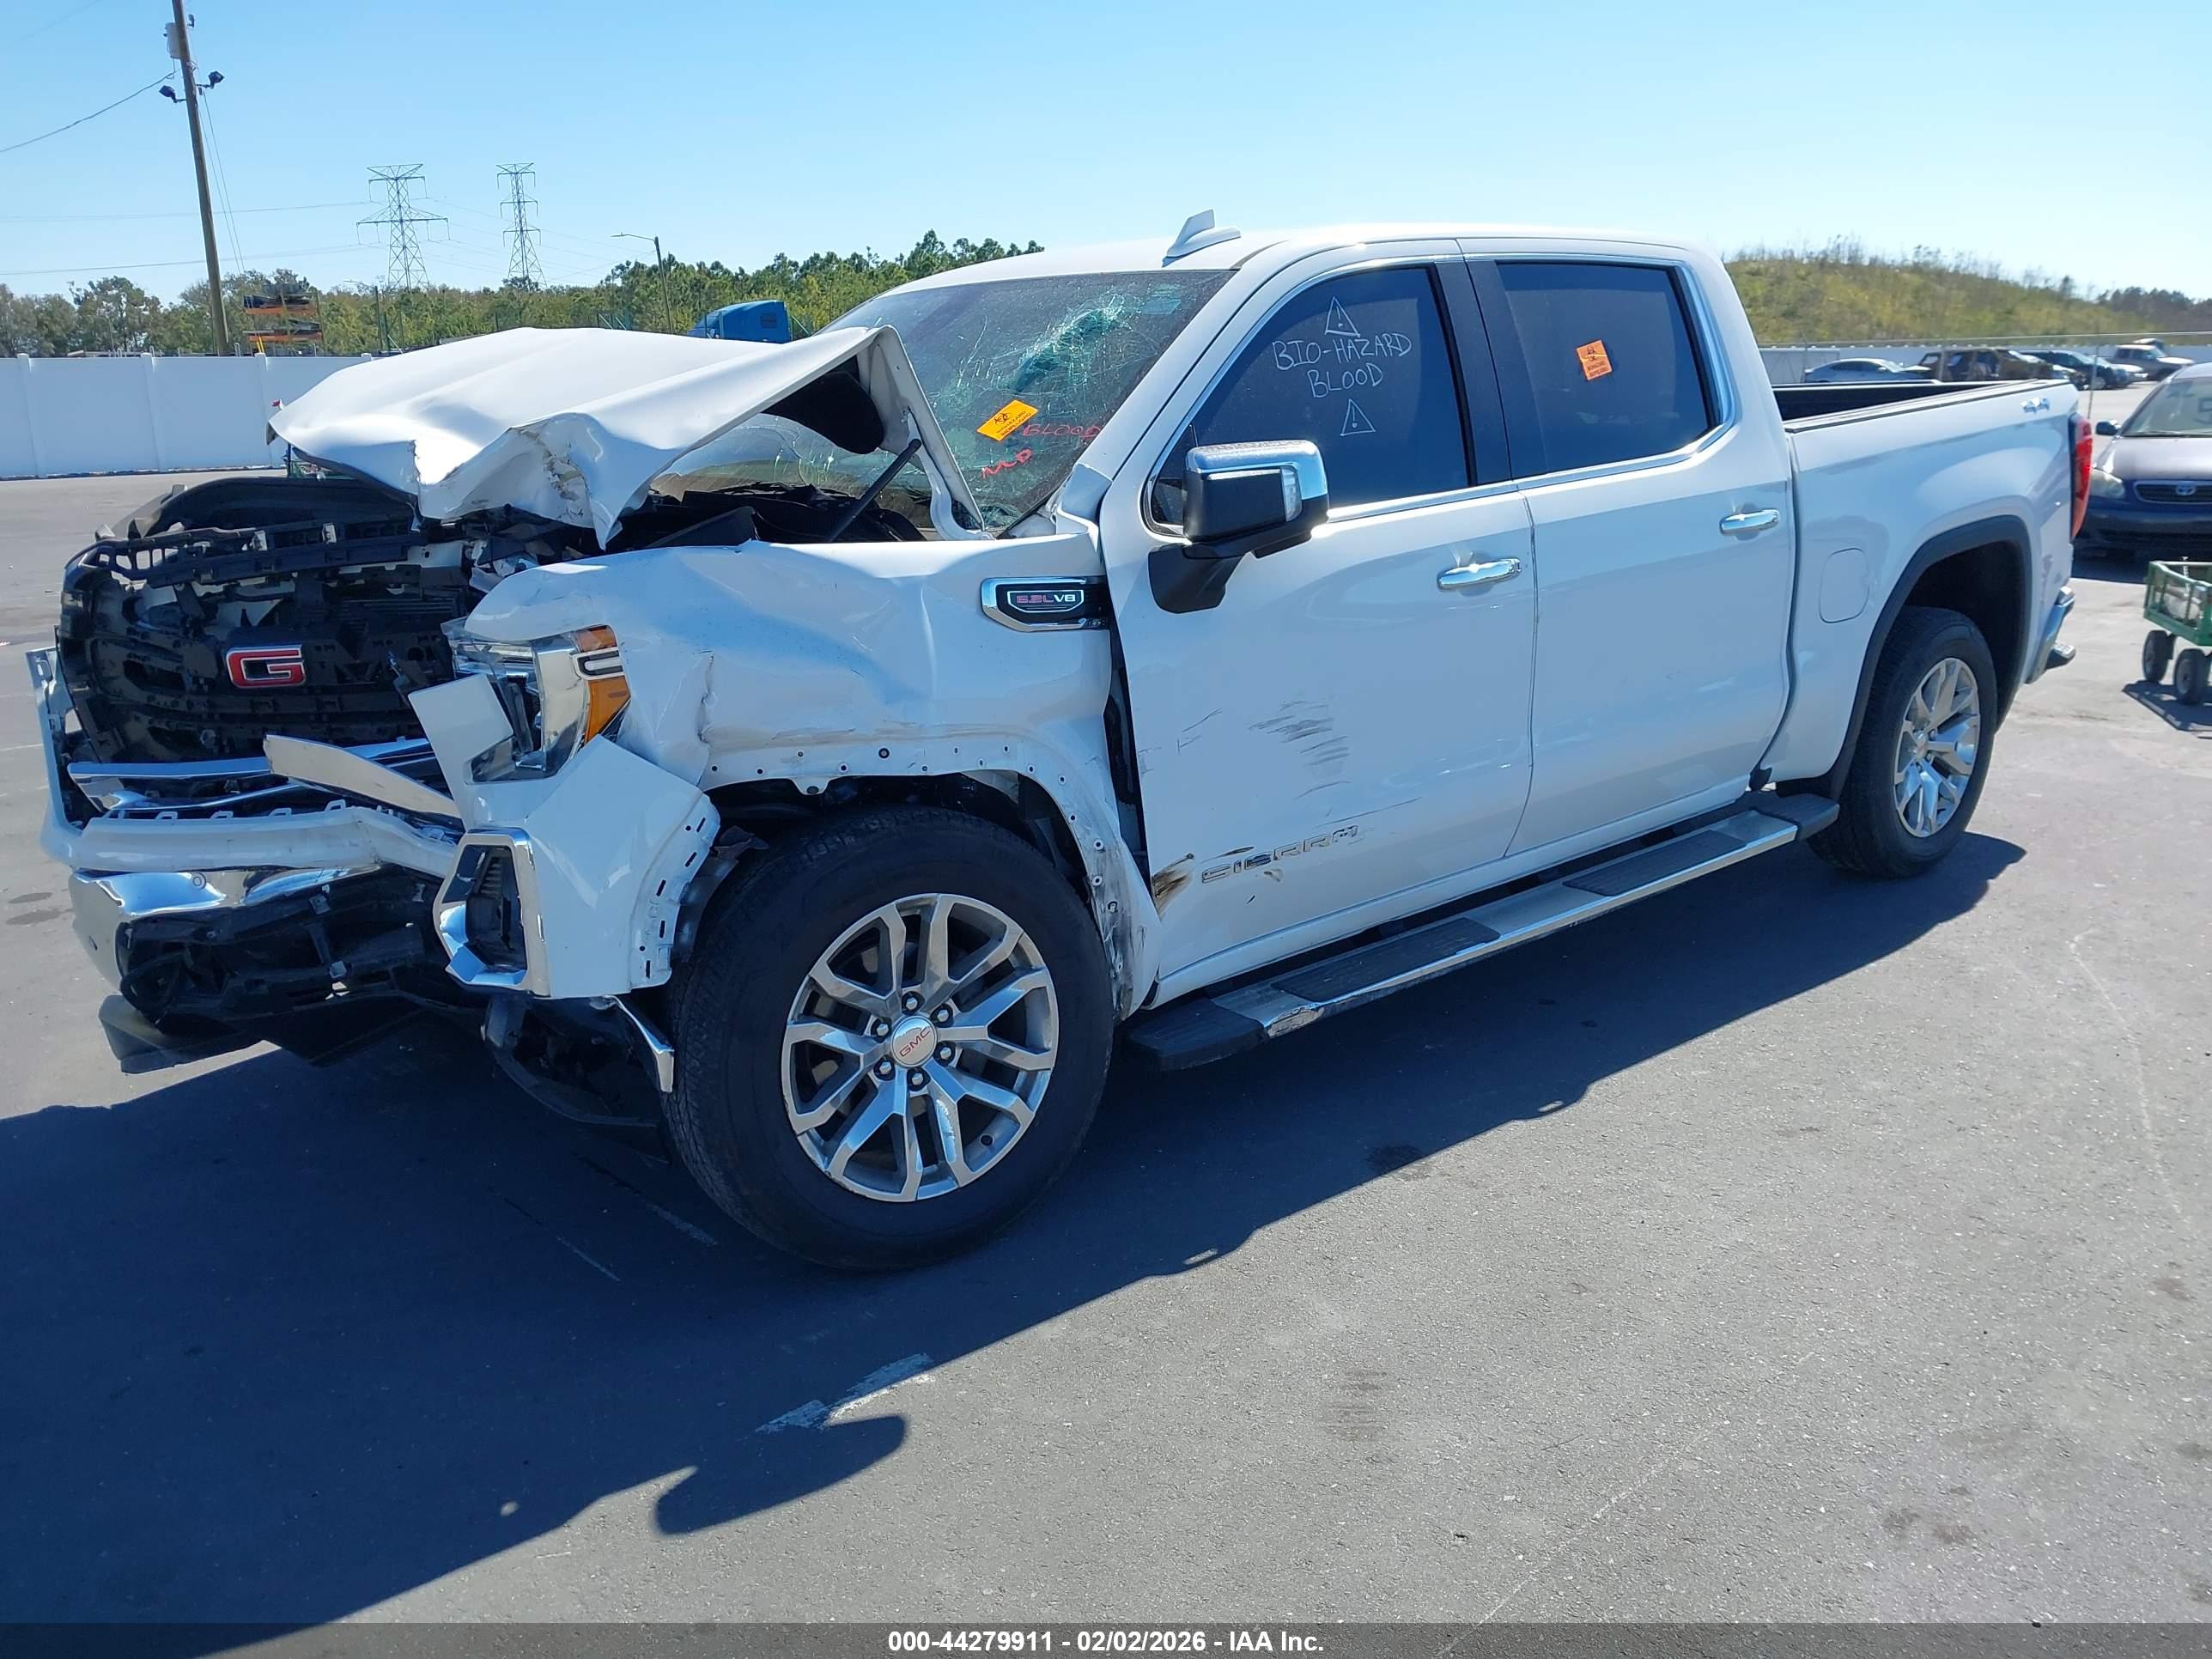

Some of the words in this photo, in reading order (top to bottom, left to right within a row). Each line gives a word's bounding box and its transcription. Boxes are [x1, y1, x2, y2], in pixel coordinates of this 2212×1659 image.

[1272, 332, 1413, 370] BIO-HAZARD
[1306, 362, 1384, 398] BLOOD
[1022, 423, 1101, 439] BLOOD
[226, 645, 307, 689] G
[1202, 824, 1358, 884] SIERRA
[899, 1026, 932, 1057] GMC
